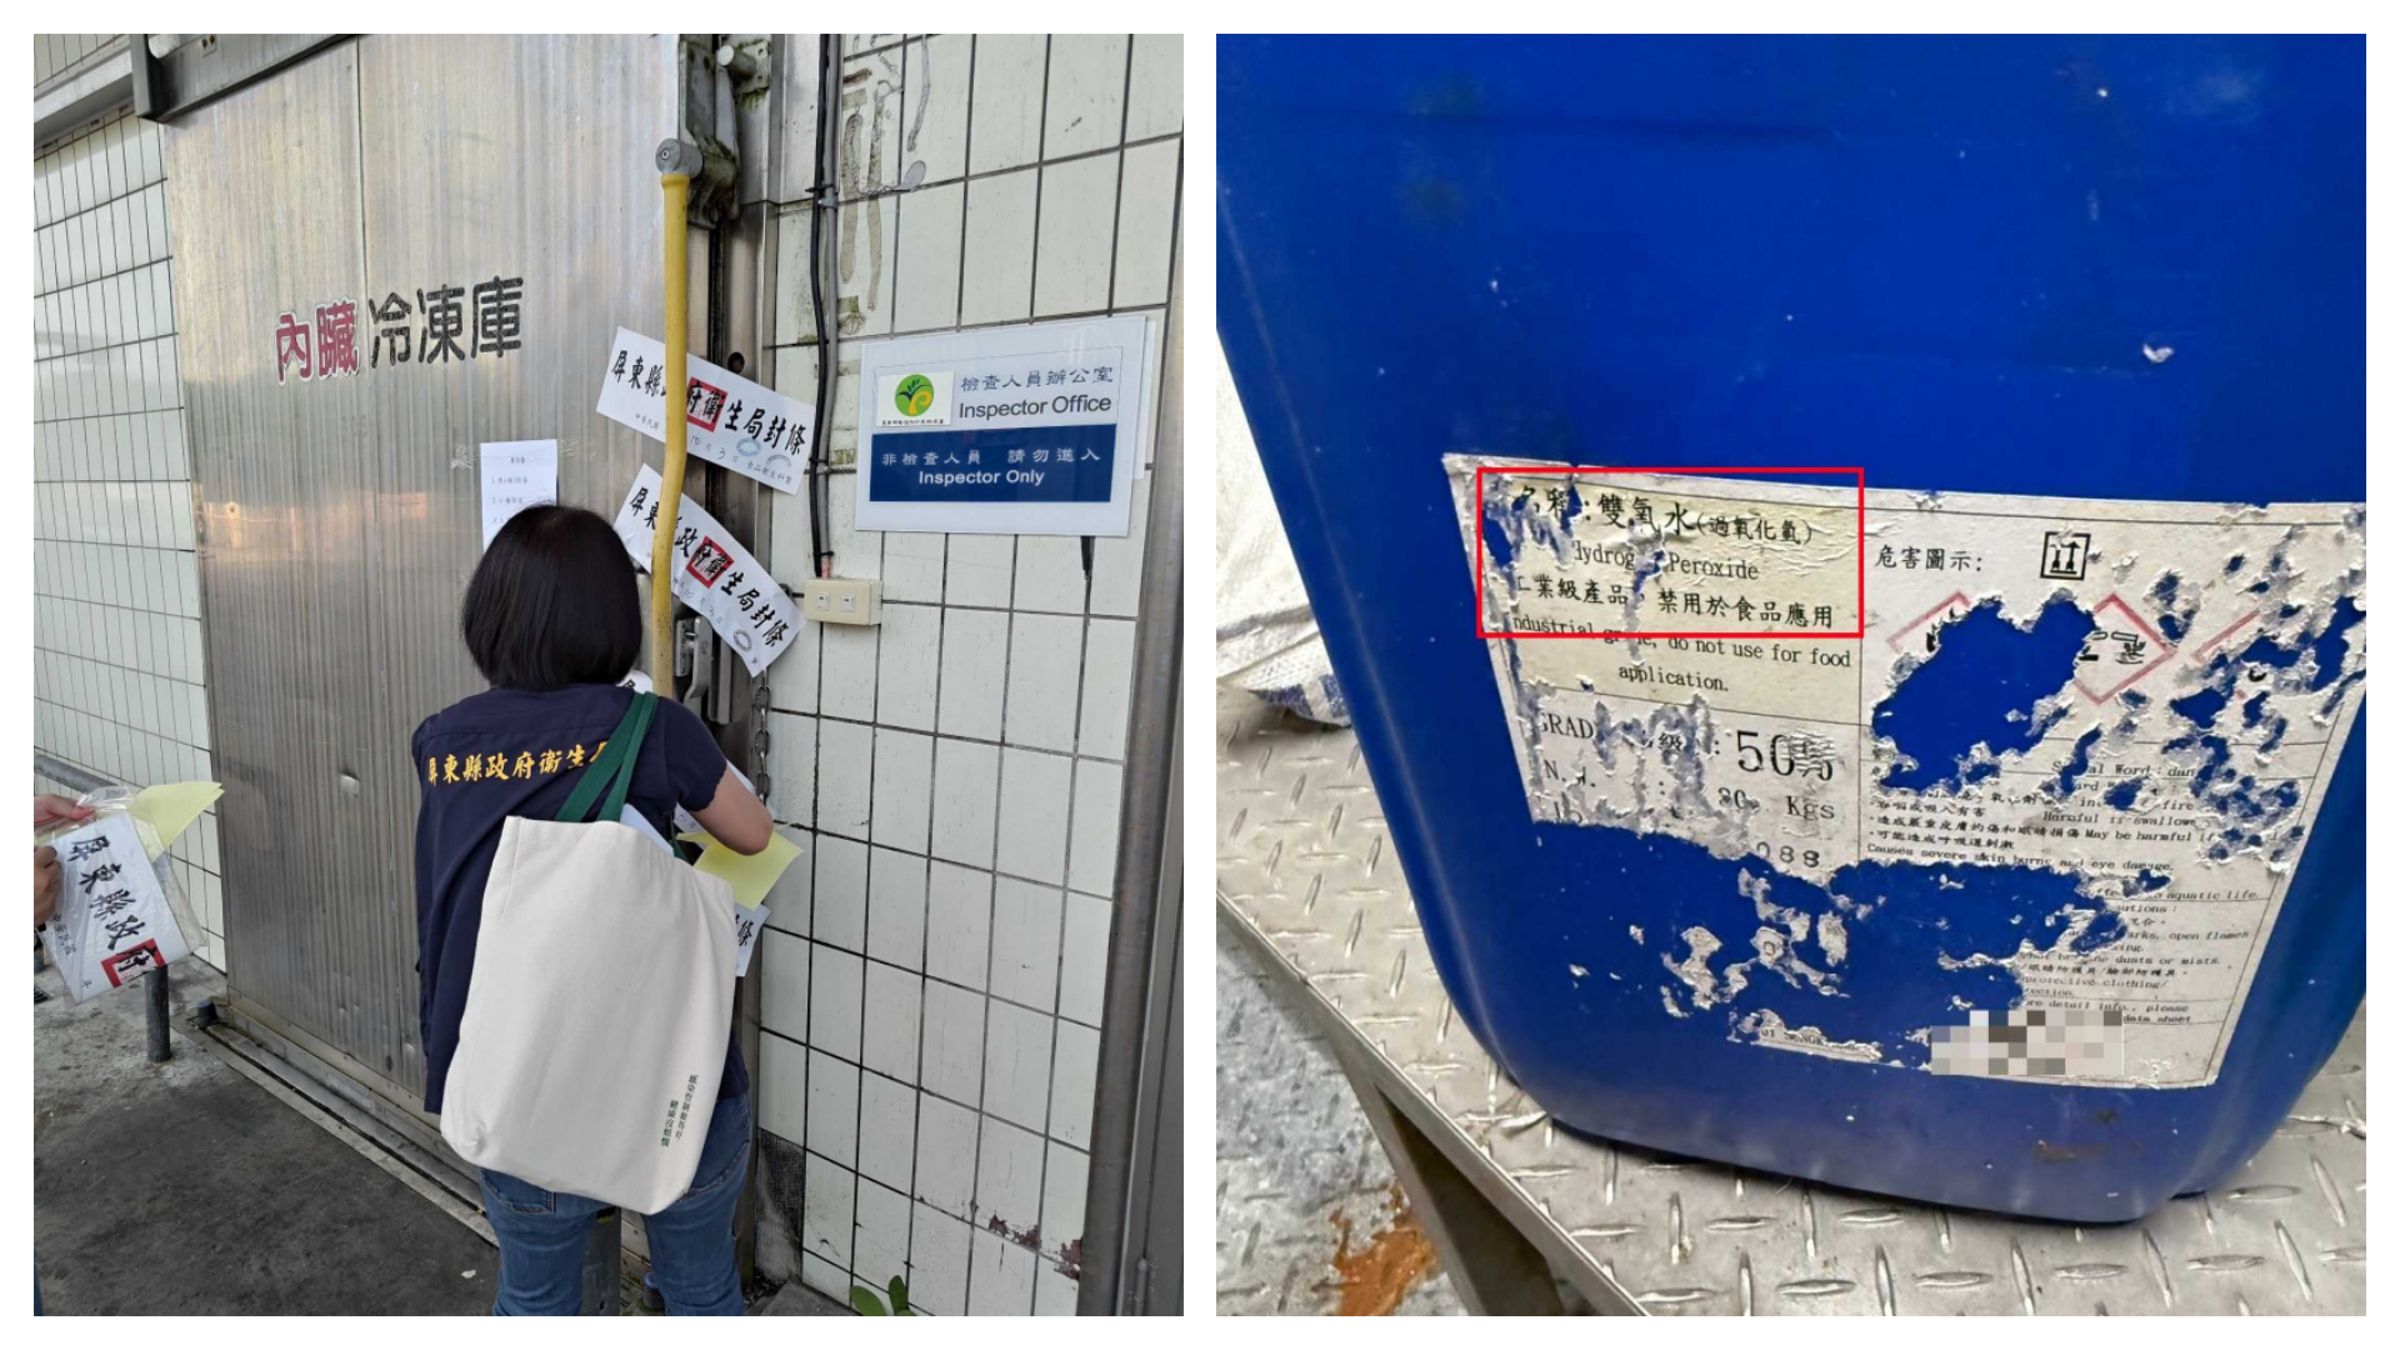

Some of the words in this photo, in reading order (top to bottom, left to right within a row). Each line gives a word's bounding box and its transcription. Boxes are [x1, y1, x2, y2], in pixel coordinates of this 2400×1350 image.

[961, 366, 1113, 391] 檢查人員辦公室
[612, 350, 806, 456] 屏東縣府衛生局封條
[959, 399, 1048, 420] Inspector
[1052, 394, 1112, 413] Office
[882, 450, 981, 466] 非檢查人員
[1007, 448, 1101, 464] 請勿進入
[919, 471, 1001, 486] Inspector
[1006, 469, 1045, 486] Only
[629, 486, 788, 648] 屏東政府衛生局封條
[1574, 540, 1636, 571] ydrog
[1669, 551, 1760, 581] Peroxide
[1513, 614, 1594, 639] ndustrial
[1696, 638, 1726, 655] not
[1732, 643, 1764, 660] use
[1771, 643, 1803, 663] for
[1810, 647, 1851, 668] food
[1618, 664, 1730, 692] application.
[1786, 795, 1836, 821] Kgs
[2043, 810, 2099, 823] Harmful
[2133, 814, 2198, 827] swallowe
[2084, 829, 2109, 841] May
[2115, 830, 2132, 841] be
[2136, 829, 2192, 842] harmful
[1867, 843, 1914, 856] Causes
[1921, 848, 1967, 860] severe
[2091, 860, 2116, 870] eye
